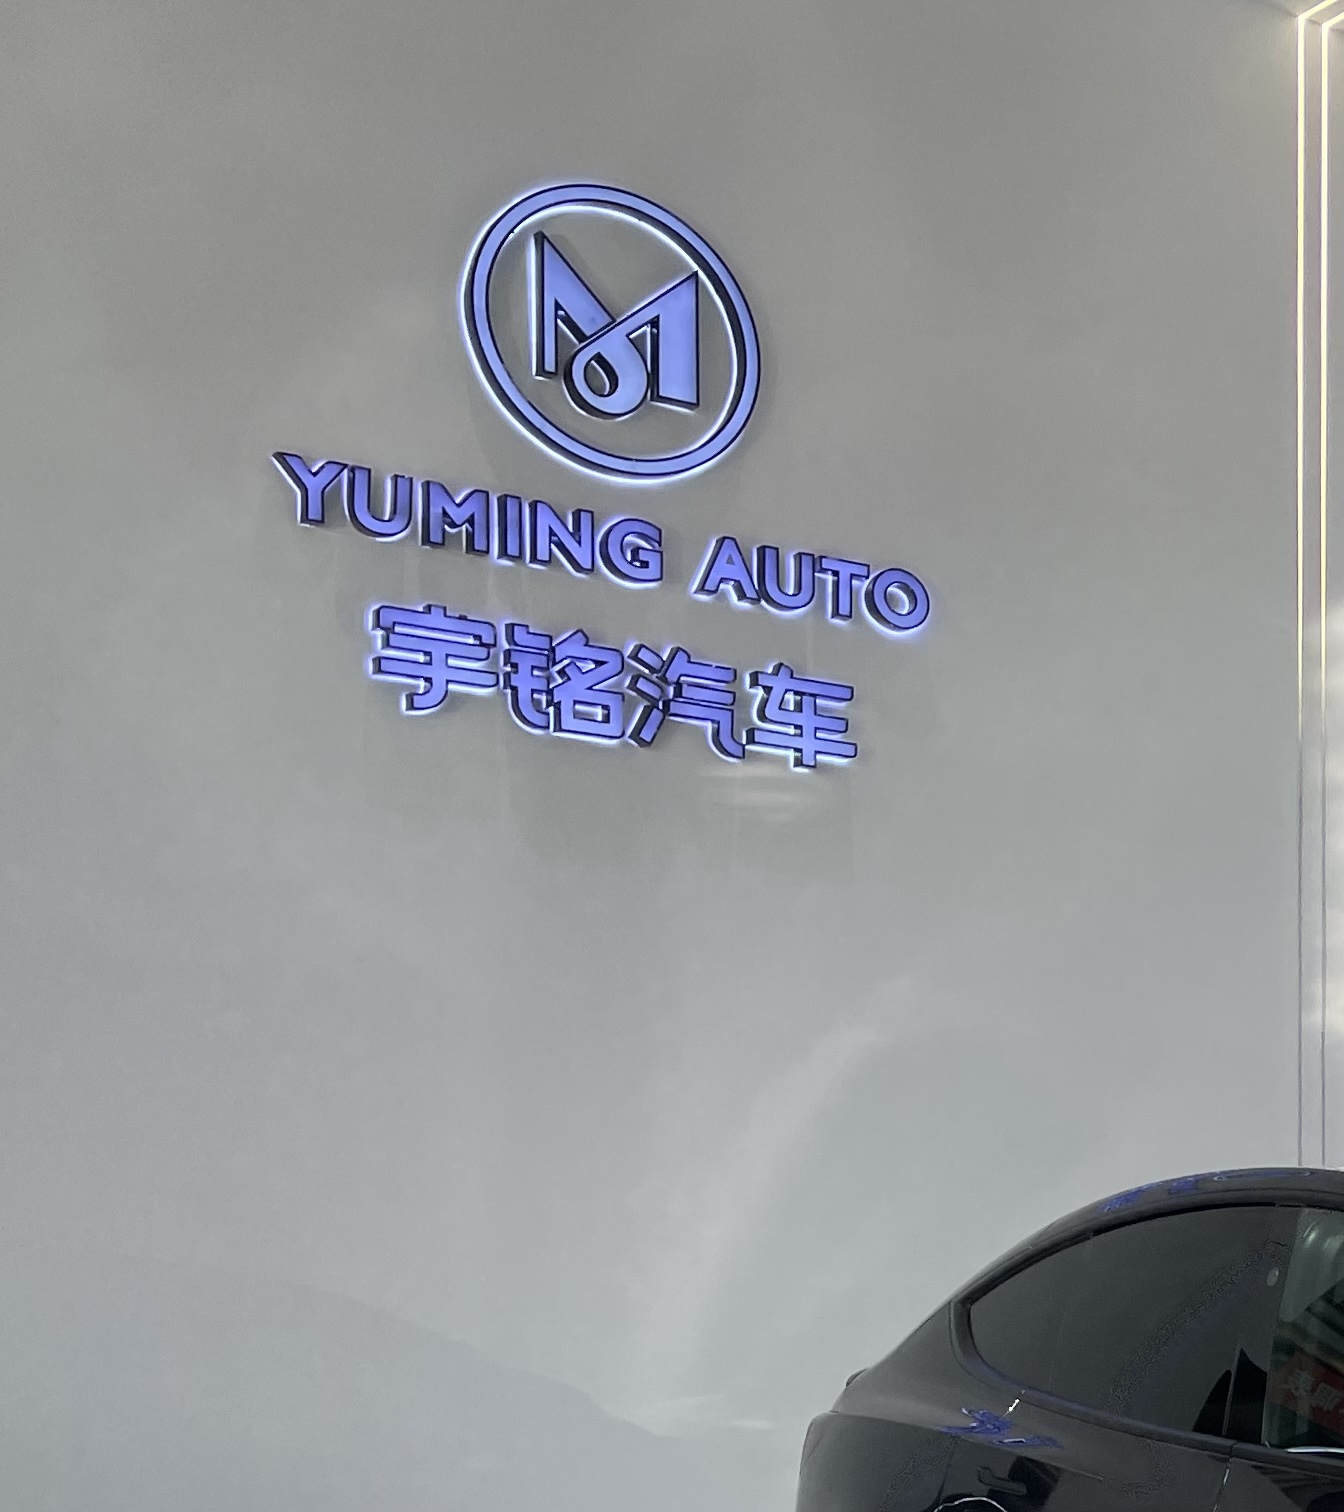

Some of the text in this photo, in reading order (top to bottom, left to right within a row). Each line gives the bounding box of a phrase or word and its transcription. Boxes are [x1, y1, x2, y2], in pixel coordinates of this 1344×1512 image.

[272, 450, 931, 632] YUMING AUTO
[370, 603, 858, 769] 宇铭汽车
